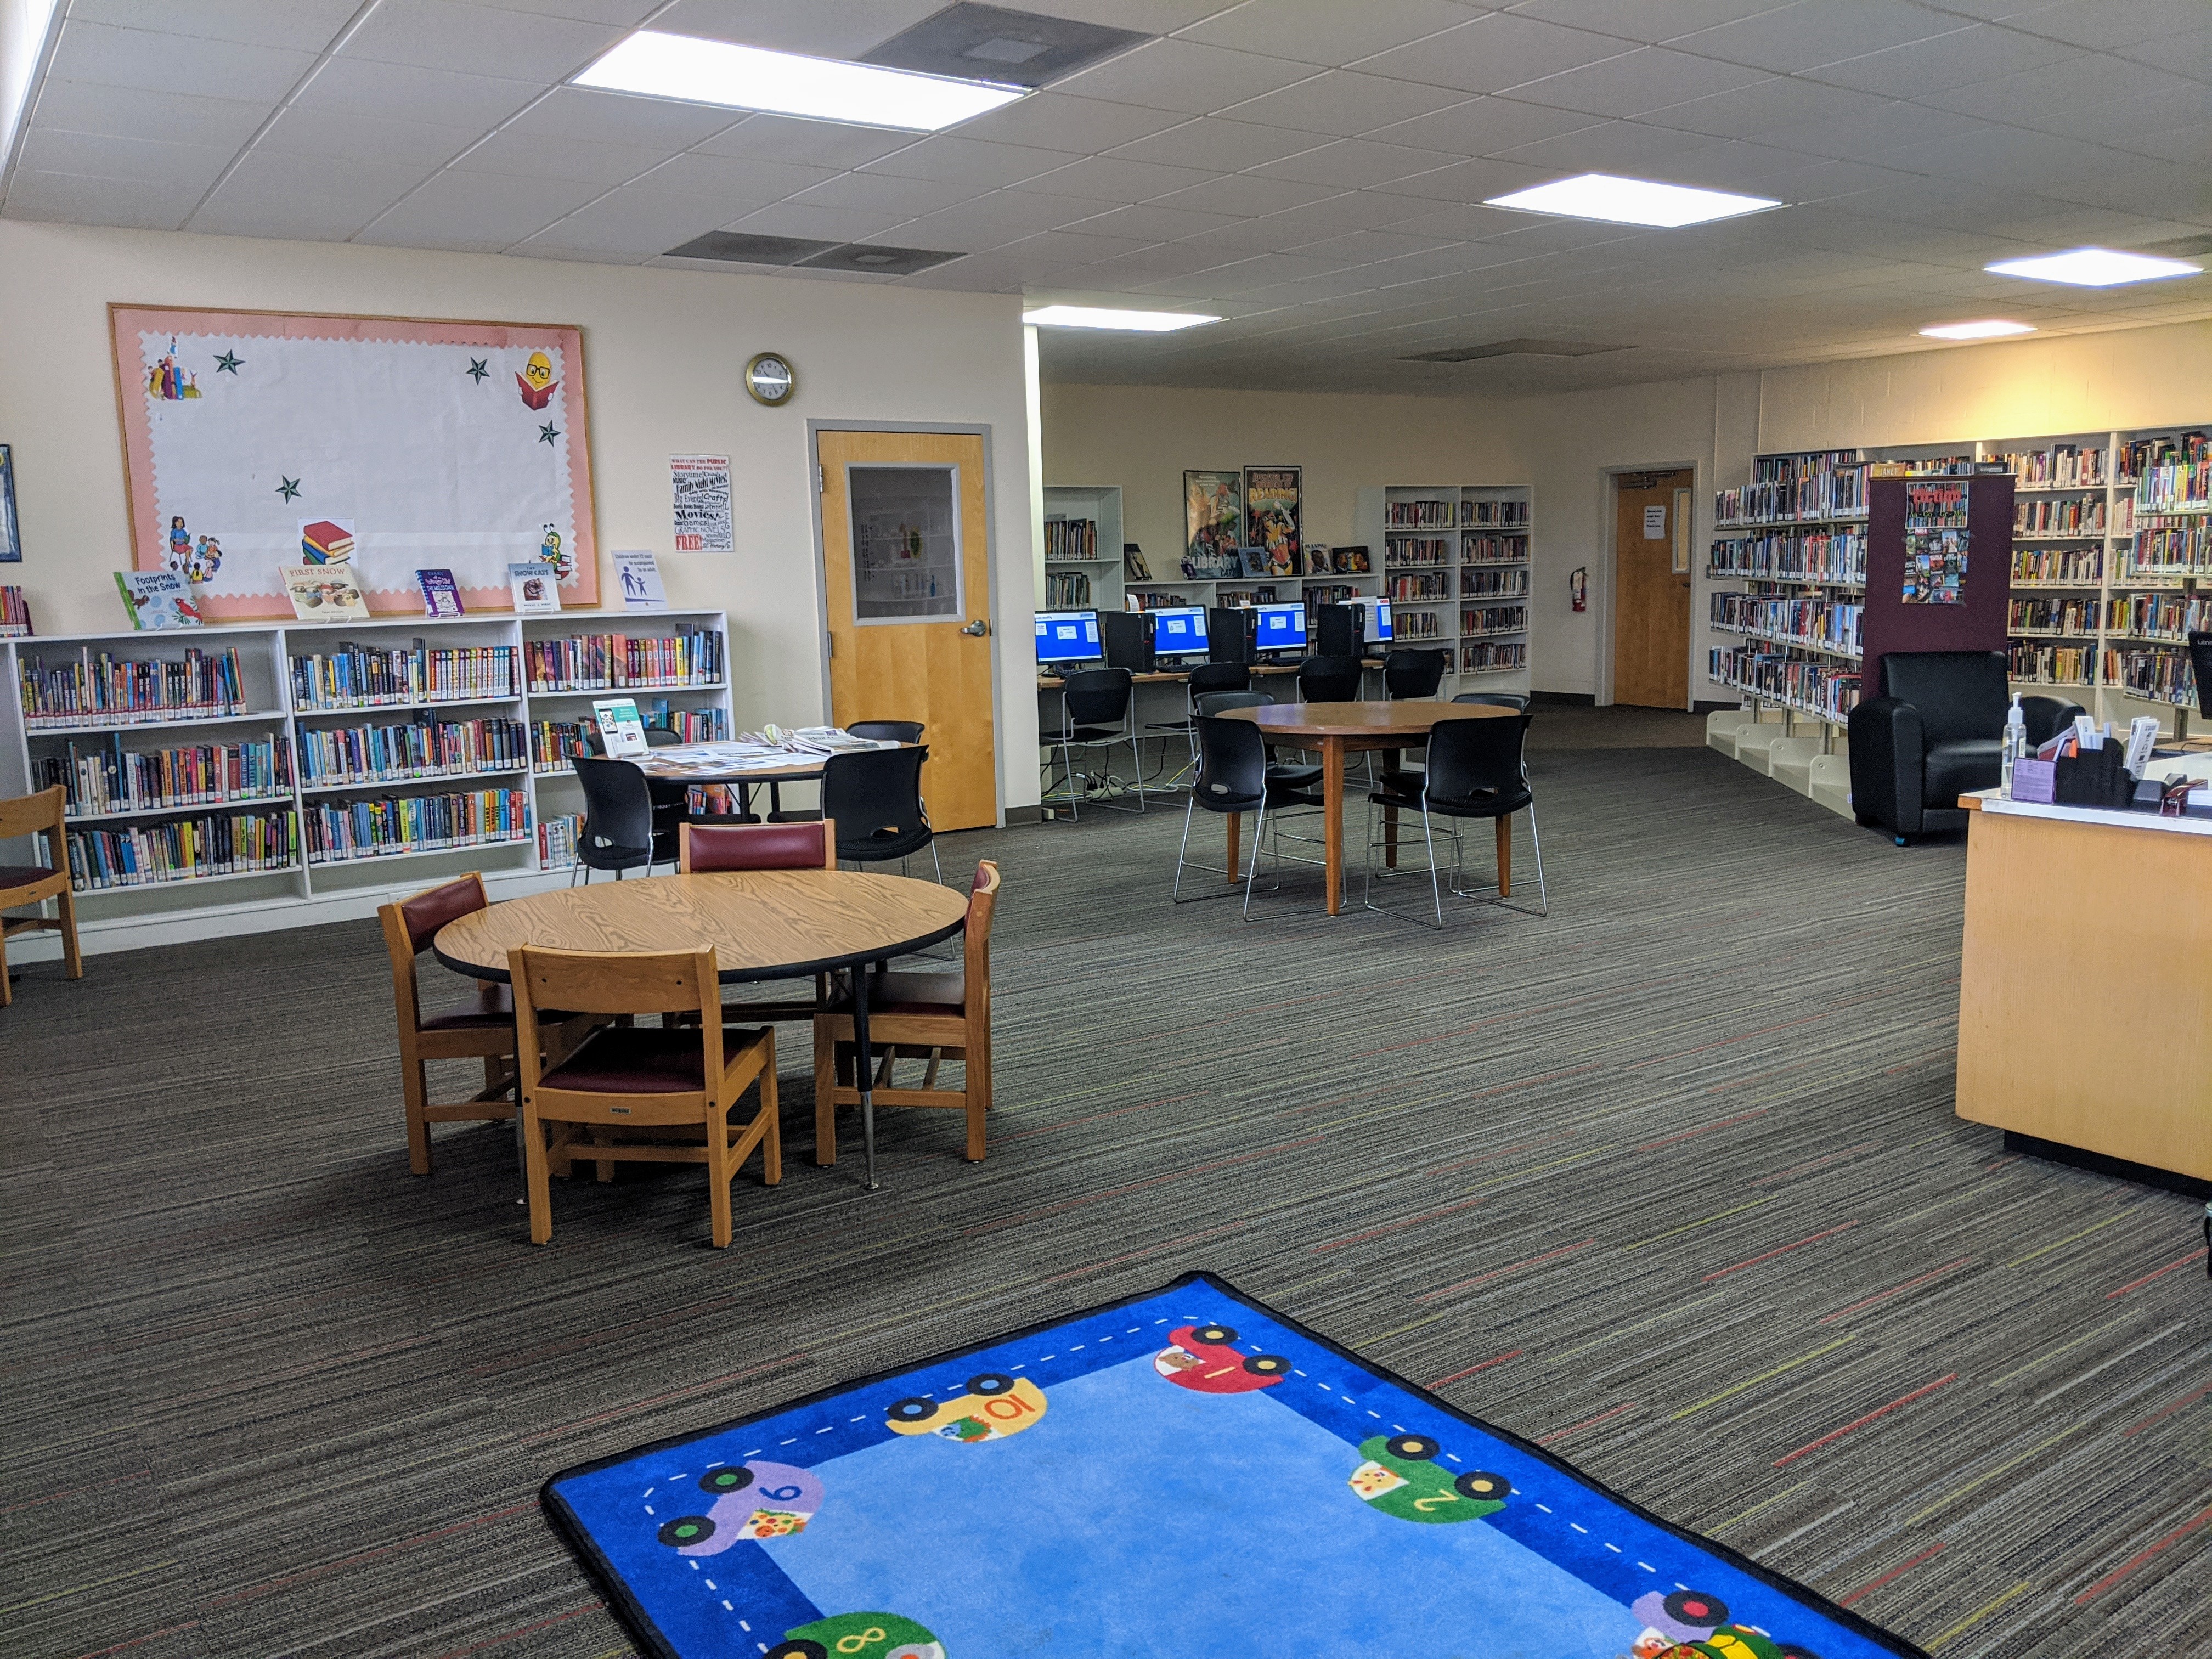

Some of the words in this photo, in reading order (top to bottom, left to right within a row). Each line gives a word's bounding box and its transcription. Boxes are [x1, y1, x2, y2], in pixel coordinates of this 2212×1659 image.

[673, 470, 704, 478] Storytime!
[676, 481, 693, 494] Family
[695, 478, 709, 489] Night
[709, 472, 727, 486] Movies!
[674, 493, 683, 504] Big
[684, 493, 704, 503] Events!
[704, 493, 729, 503] Crafts!
[1914, 487, 1961, 504] Fiction
[675, 509, 719, 521] Movies!
[684, 518, 709, 527] Games!
[675, 526, 698, 534] GRAPHIC
[701, 526, 725, 534] NOVELS
[676, 535, 702, 550] FREE!
[1192, 556, 1238, 569] LIBRARY
[289, 568, 314, 577] FIRST
[135, 573, 175, 585] Footprints
[160, 582, 181, 591] Snow
[984, 1393, 1035, 1420] 10
[1414, 1489, 1459, 1512] 2
[836, 1627, 886, 1654] 8
